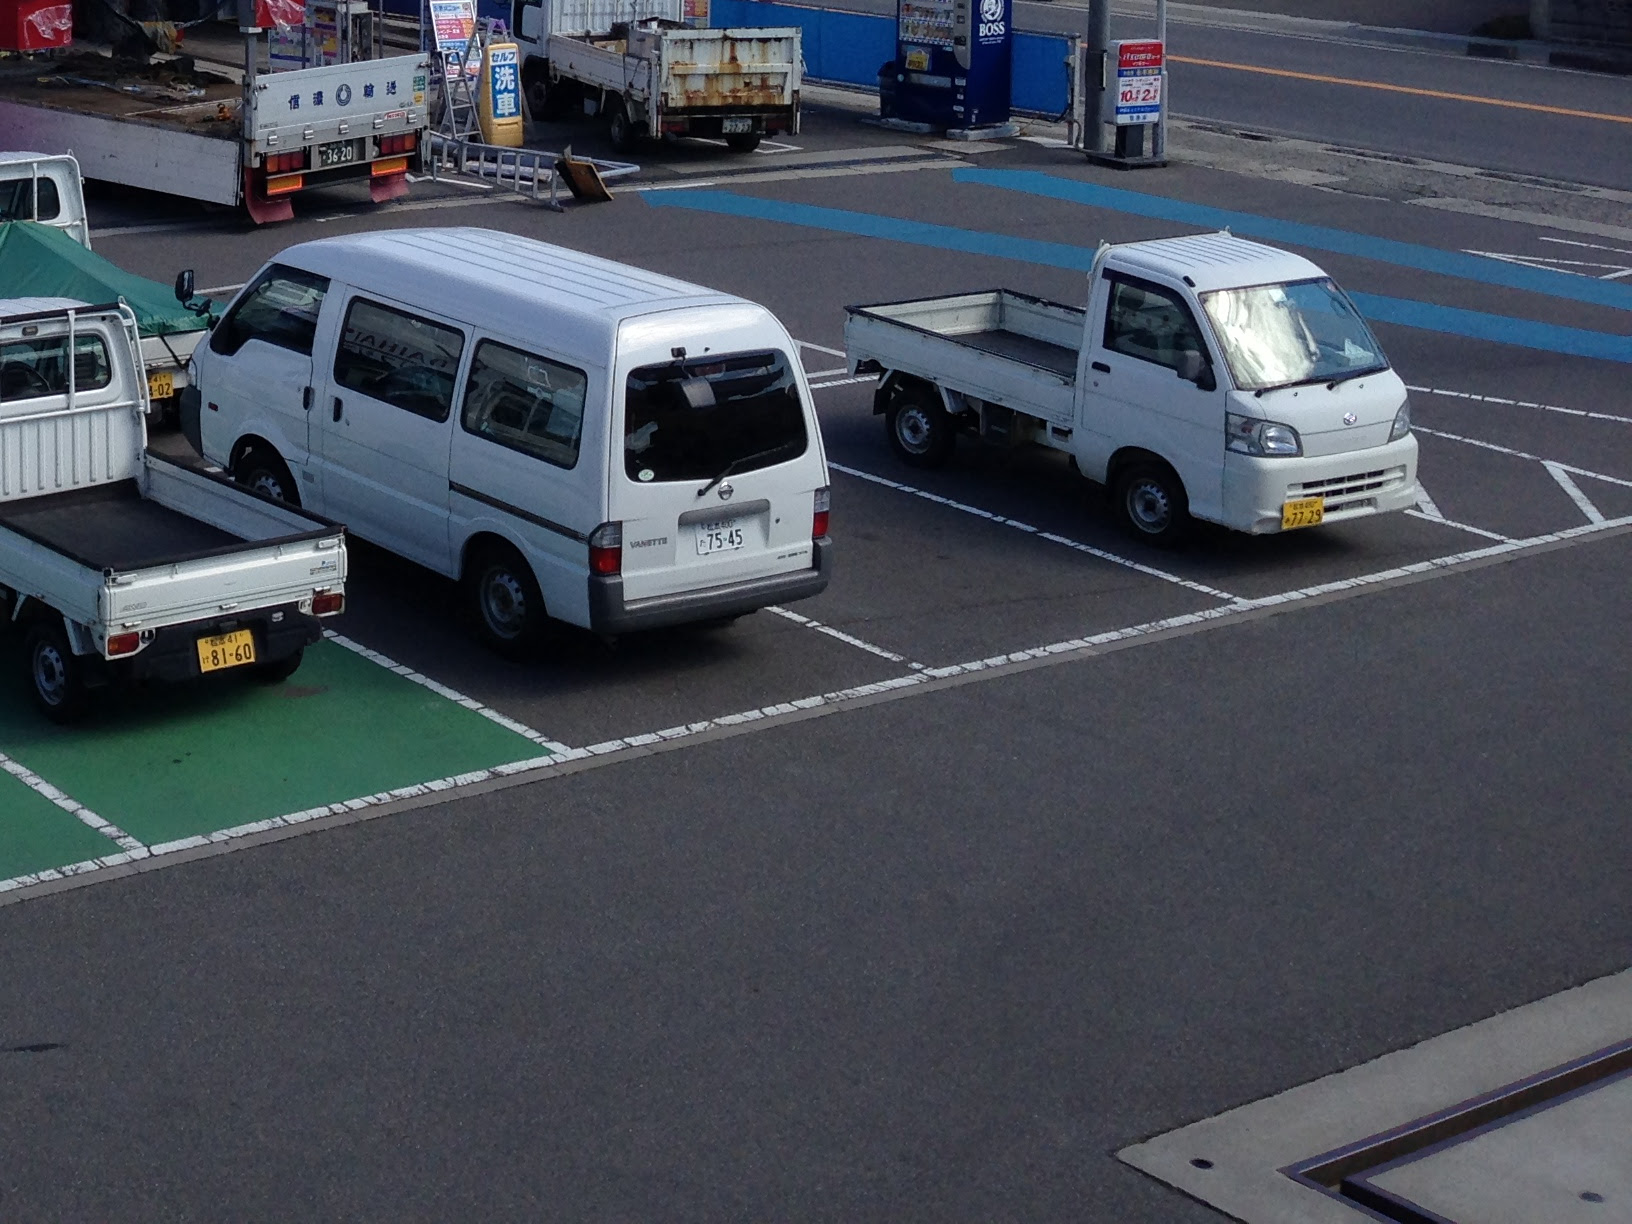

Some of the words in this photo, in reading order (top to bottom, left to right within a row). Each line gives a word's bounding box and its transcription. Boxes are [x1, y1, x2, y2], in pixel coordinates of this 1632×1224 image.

[978, 21, 1006, 37] BOSS
[491, 51, 517, 62] セルフ
[494, 66, 517, 117] 洗車
[707, 528, 744, 551] 75-45
[211, 643, 252, 666] 81-60
